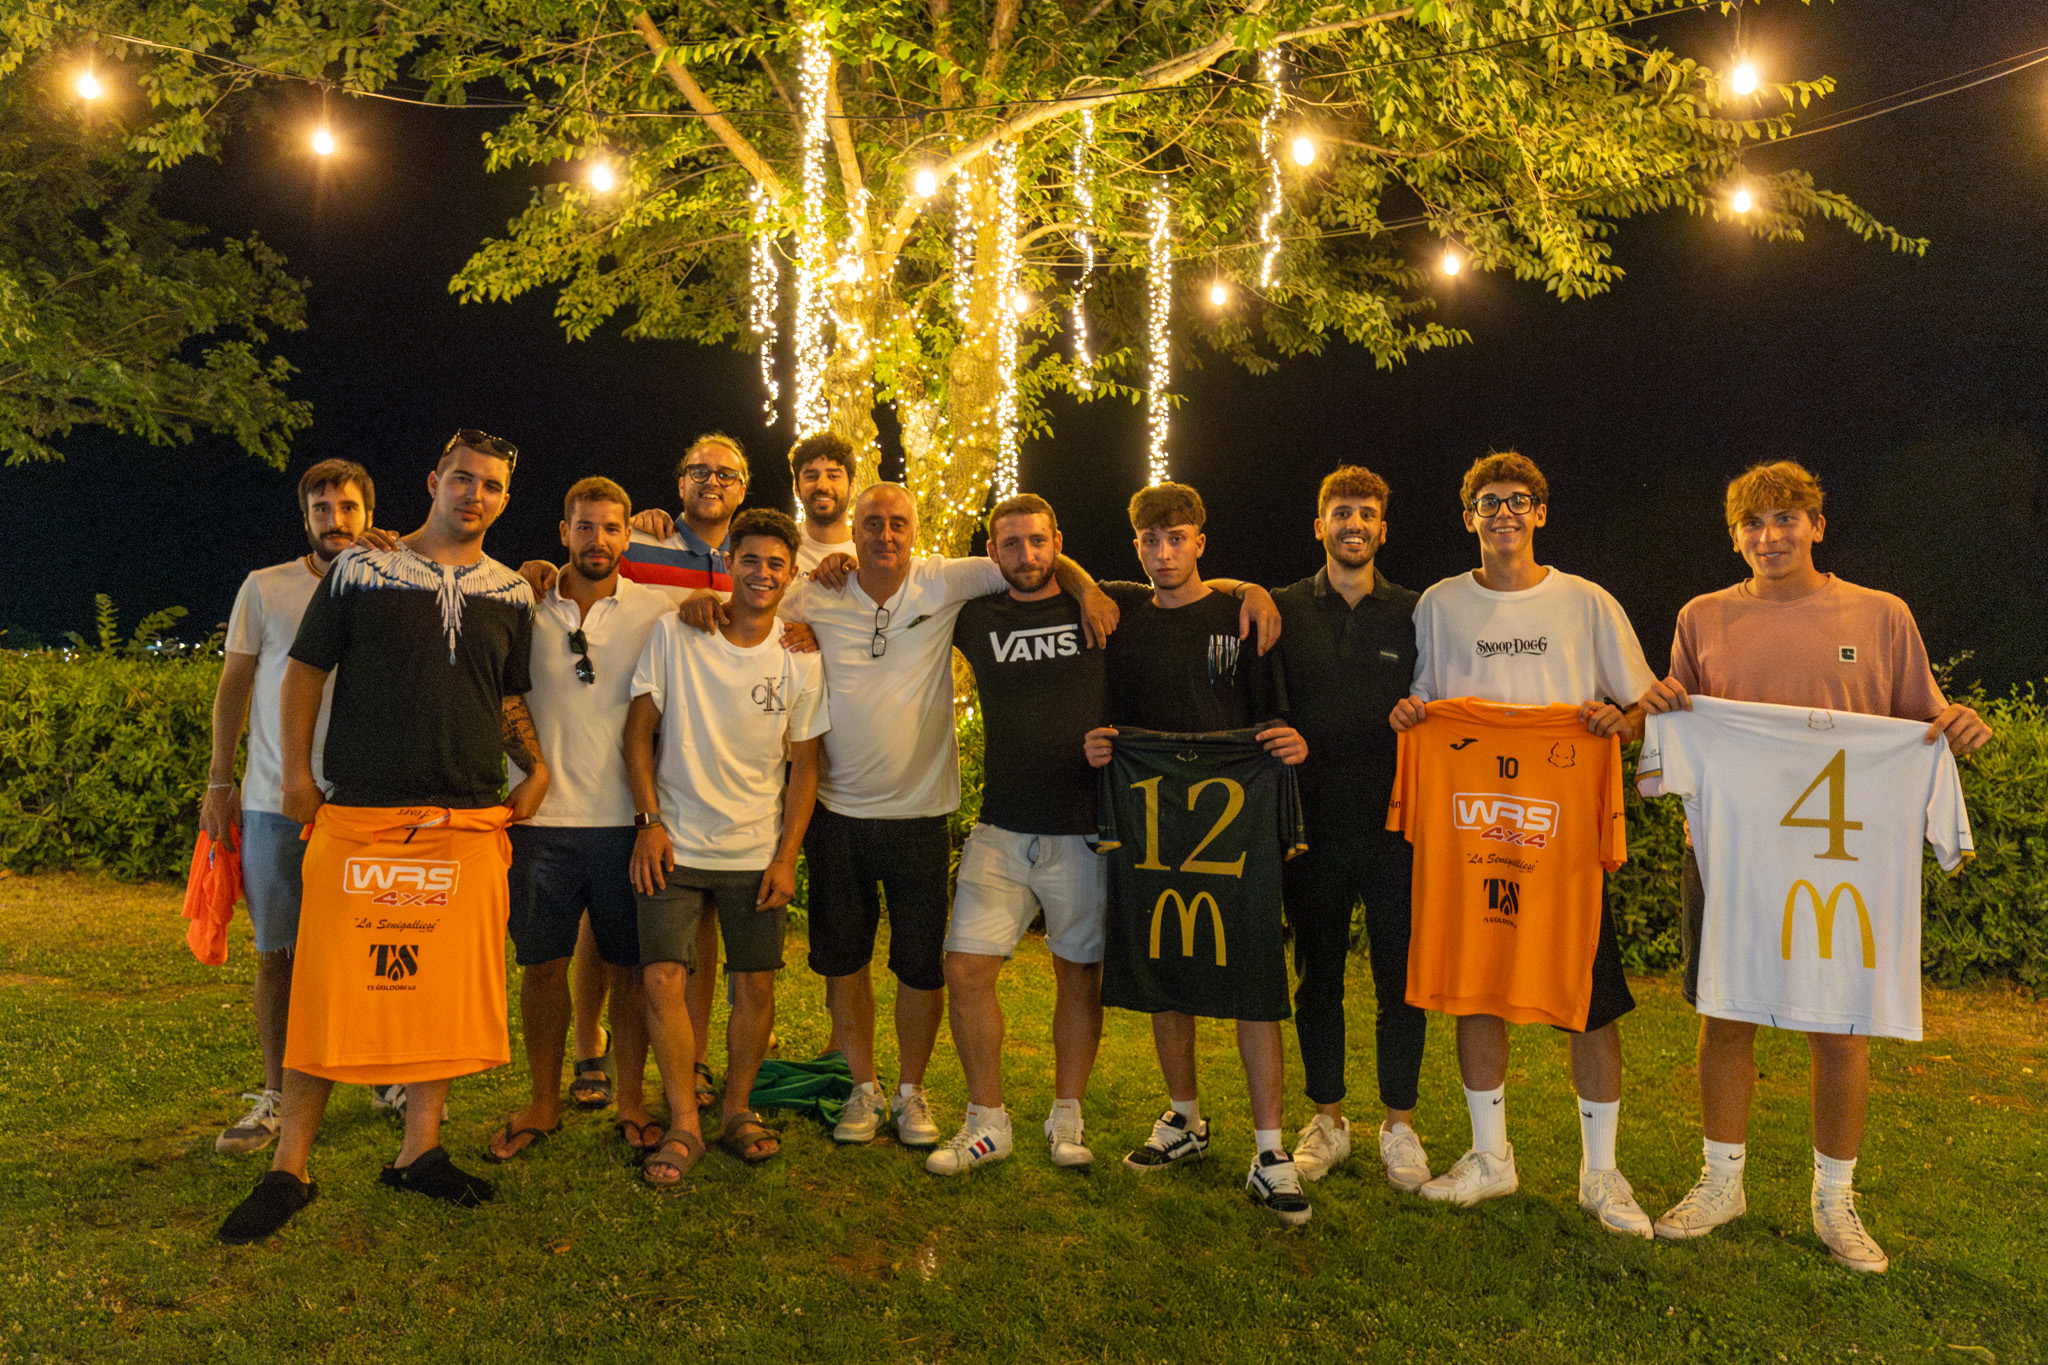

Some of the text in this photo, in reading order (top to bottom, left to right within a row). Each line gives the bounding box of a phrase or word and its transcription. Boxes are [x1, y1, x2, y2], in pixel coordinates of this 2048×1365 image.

[990, 624, 1078, 663] VANS
[1476, 637, 1547, 655] SNOOP DOGG
[1497, 756, 1519, 779] 10
[1458, 800, 1552, 831] WRS
[1780, 749, 1863, 862] 4
[1130, 776, 1246, 878] 12
[352, 864, 454, 890] WRS
[1483, 878, 1520, 915] TS
[369, 944, 419, 980] TS
